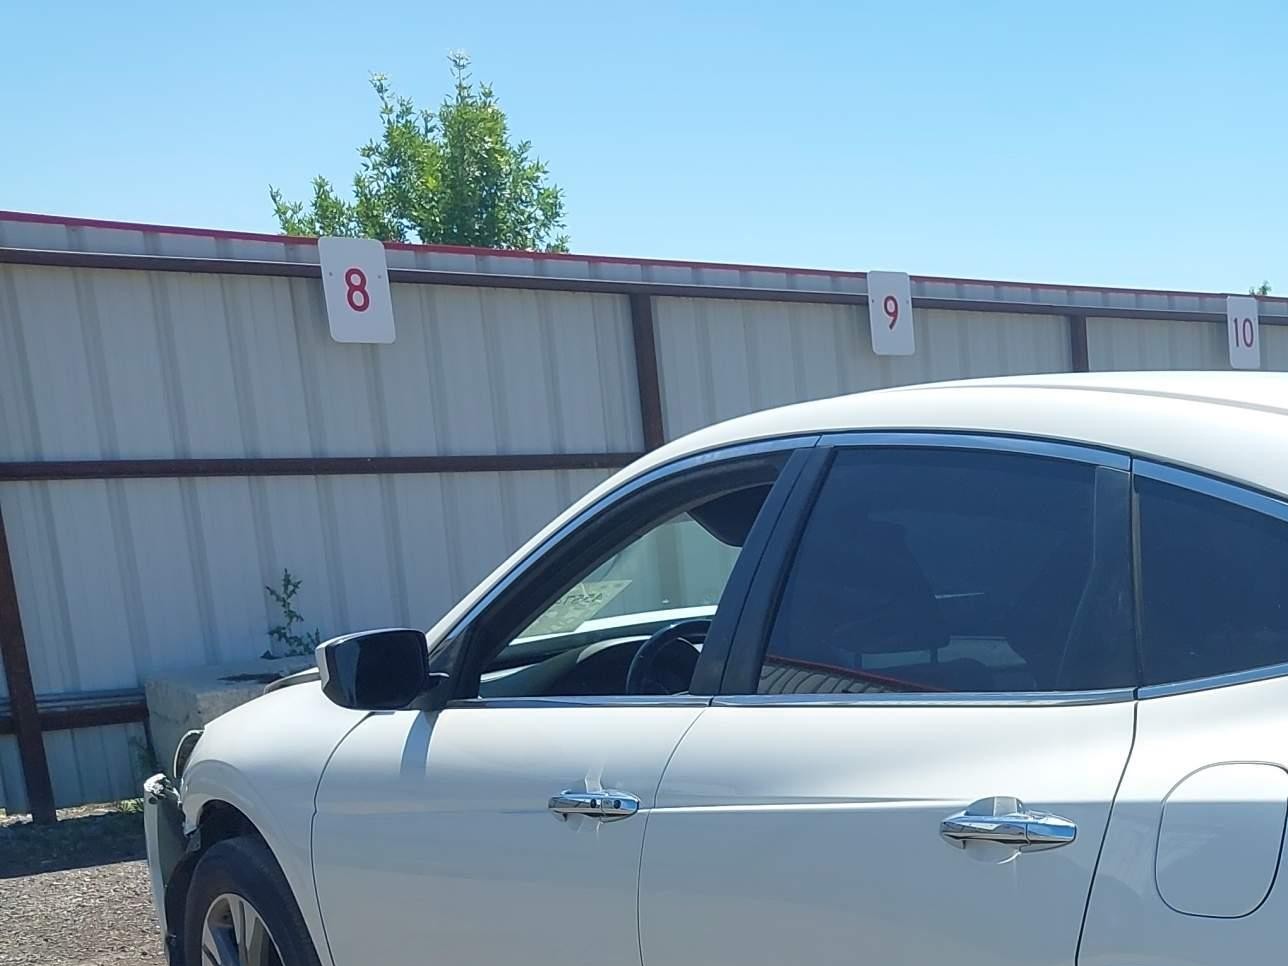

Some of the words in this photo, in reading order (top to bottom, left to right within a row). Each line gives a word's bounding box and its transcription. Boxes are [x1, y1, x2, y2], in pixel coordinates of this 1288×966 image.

[345, 268, 370, 312] 8
[884, 295, 899, 330] 9
[1234, 317, 1254, 348] 10
